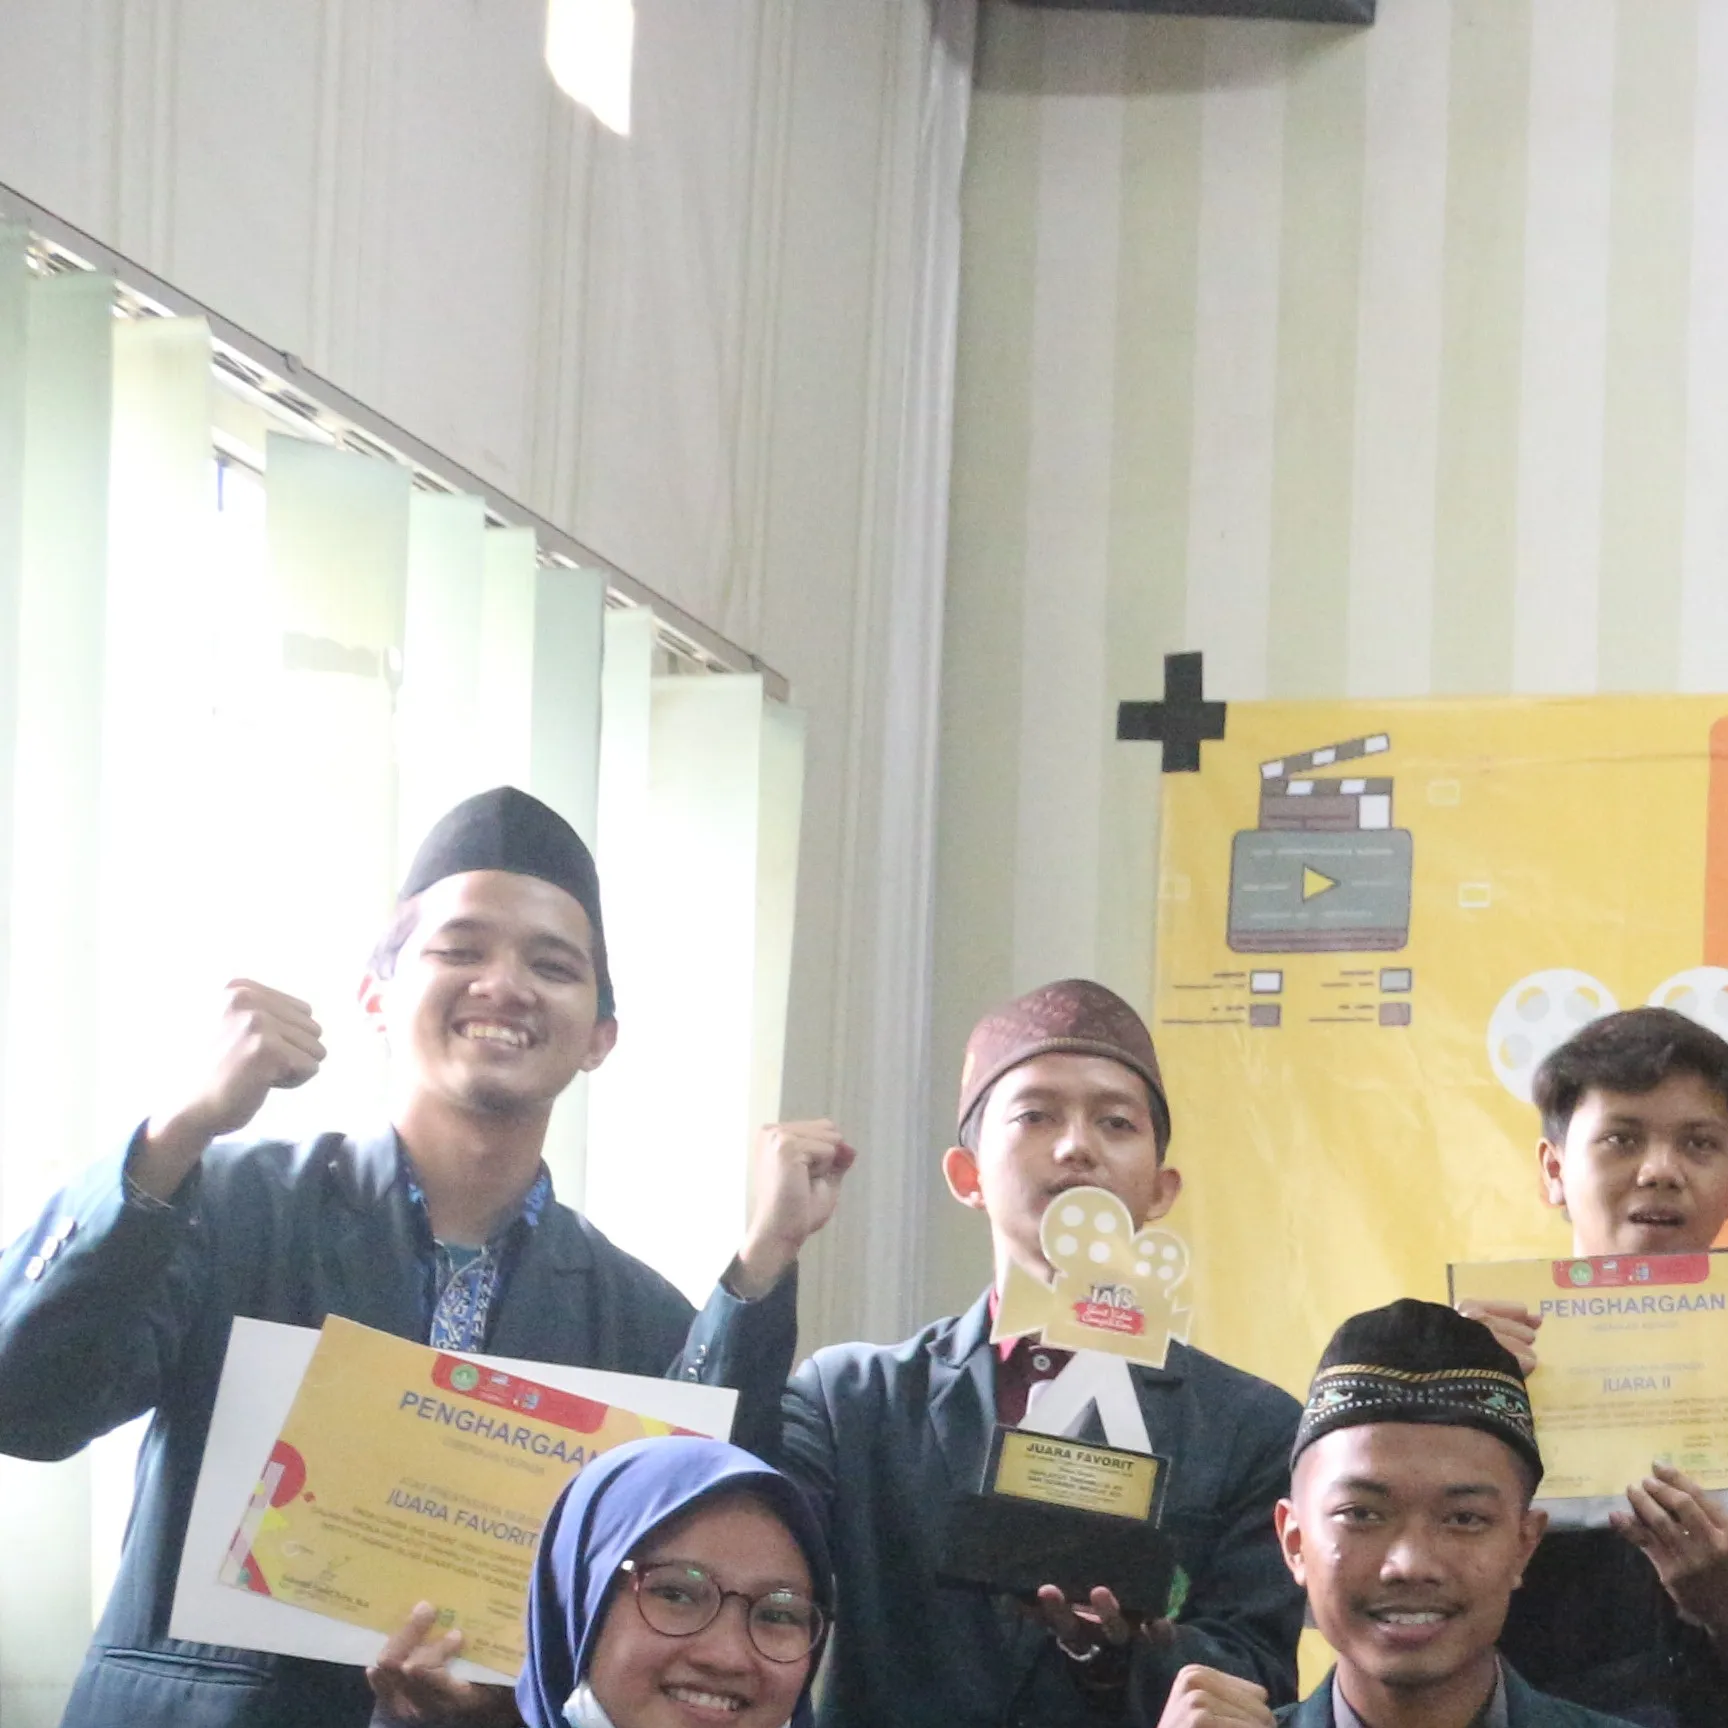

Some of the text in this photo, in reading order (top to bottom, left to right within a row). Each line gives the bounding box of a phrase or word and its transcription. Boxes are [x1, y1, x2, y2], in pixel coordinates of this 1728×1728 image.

[1539, 1293, 1727, 1319] PENGHARGAAN
[1026, 1442, 1135, 1470] JUARA FAVORIT
[387, 1488, 449, 1522] JUARA
